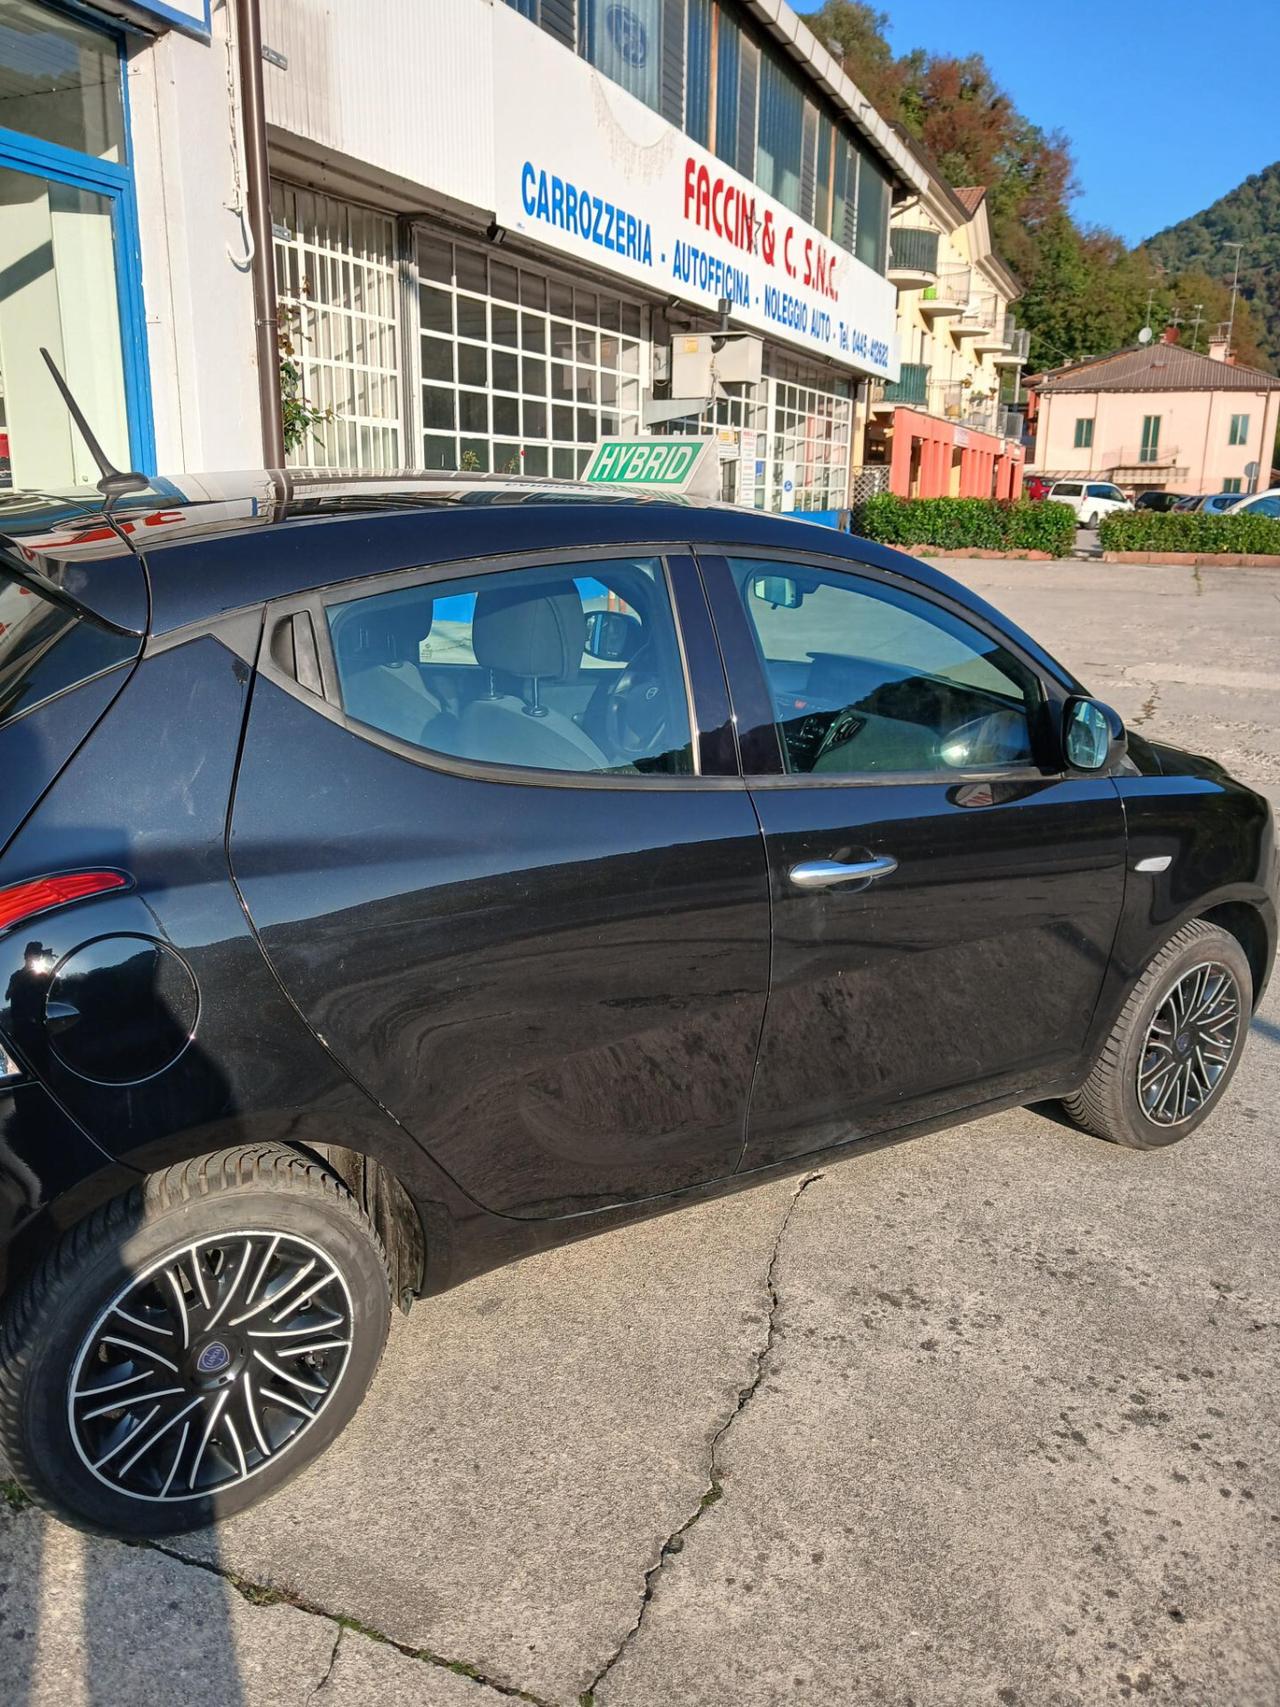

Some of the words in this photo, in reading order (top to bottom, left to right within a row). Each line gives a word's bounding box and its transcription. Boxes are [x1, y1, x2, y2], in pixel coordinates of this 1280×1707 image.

[521, 161, 653, 267] CARROZZERIA
[672, 239, 750, 309] AUTOFFICINA
[764, 284, 807, 333] NOLEGGIO
[810, 308, 831, 343] AUTO
[684, 157, 756, 255] FACCIN
[762, 209, 776, 267] &
[784, 226, 797, 279] C.
[803, 238, 839, 302] S.N.C.
[592, 445, 693, 480] HYBRID
